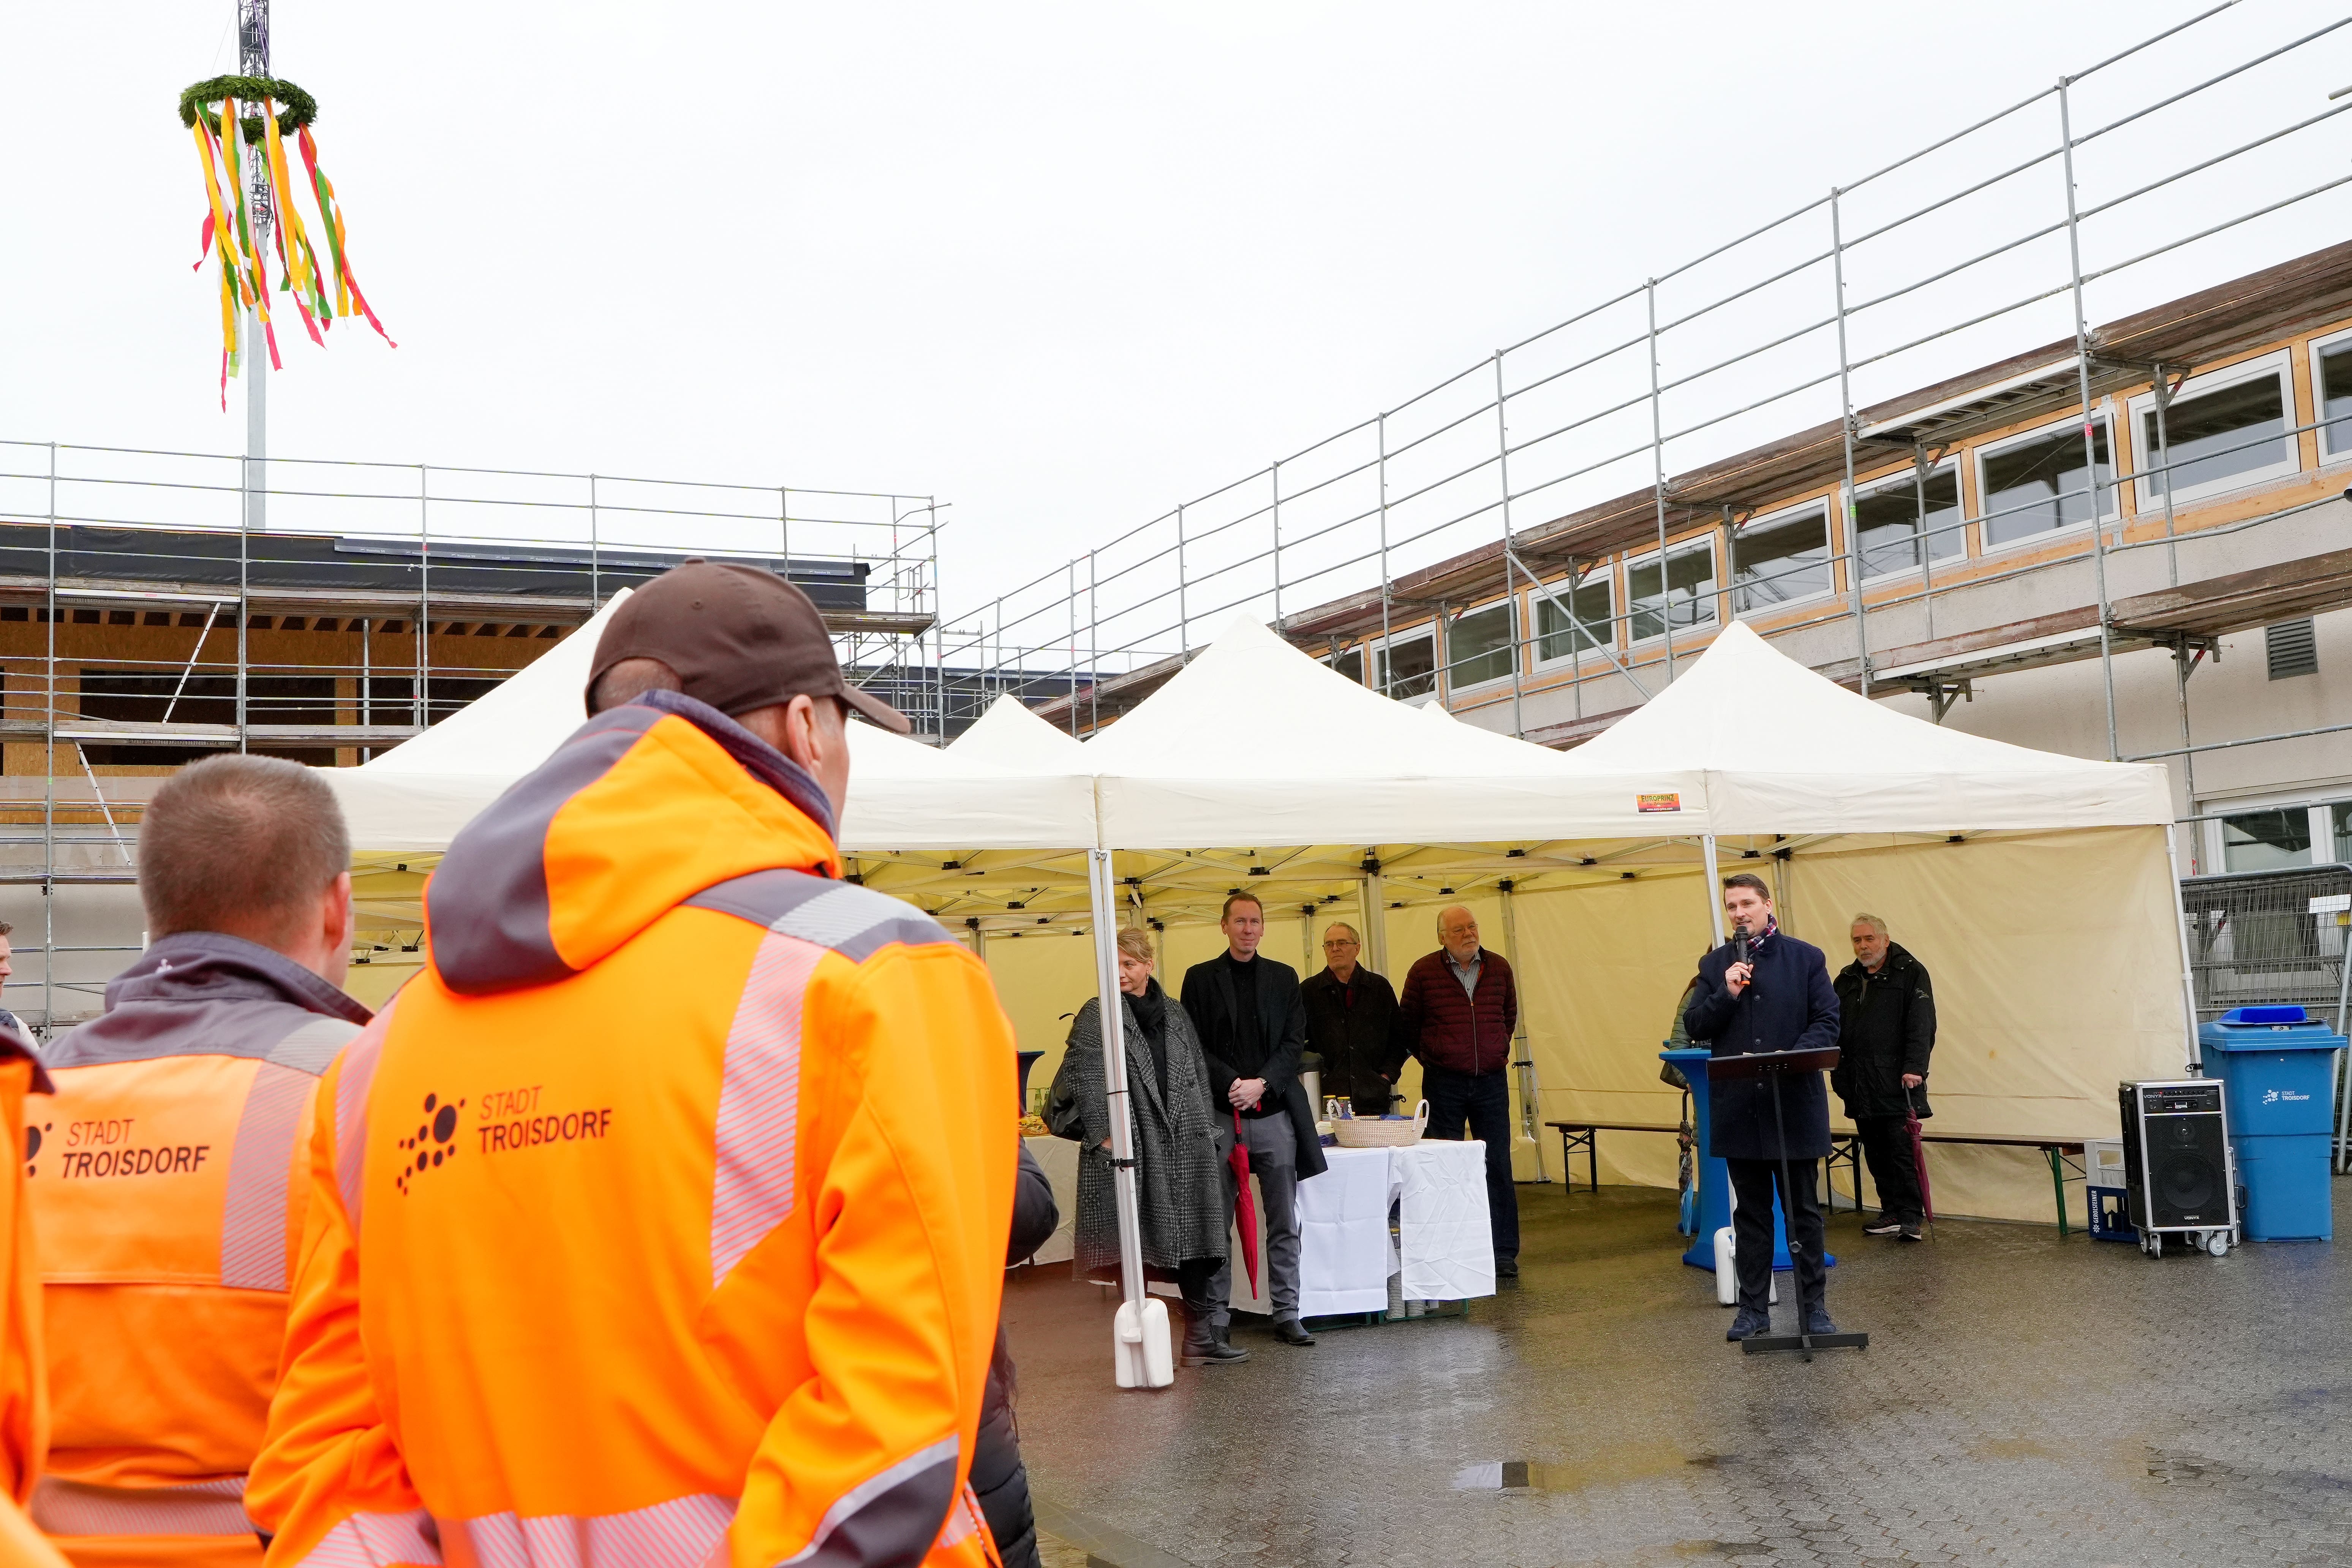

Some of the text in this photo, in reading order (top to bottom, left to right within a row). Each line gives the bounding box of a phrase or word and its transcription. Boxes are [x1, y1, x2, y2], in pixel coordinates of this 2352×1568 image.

[1641, 794, 1675, 802] EUROPRINZ
[480, 1085, 543, 1120] STADT
[67, 1119, 135, 1146] STADT
[478, 1108, 612, 1154] TROISDORF
[63, 1146, 210, 1178] TROISDORF
